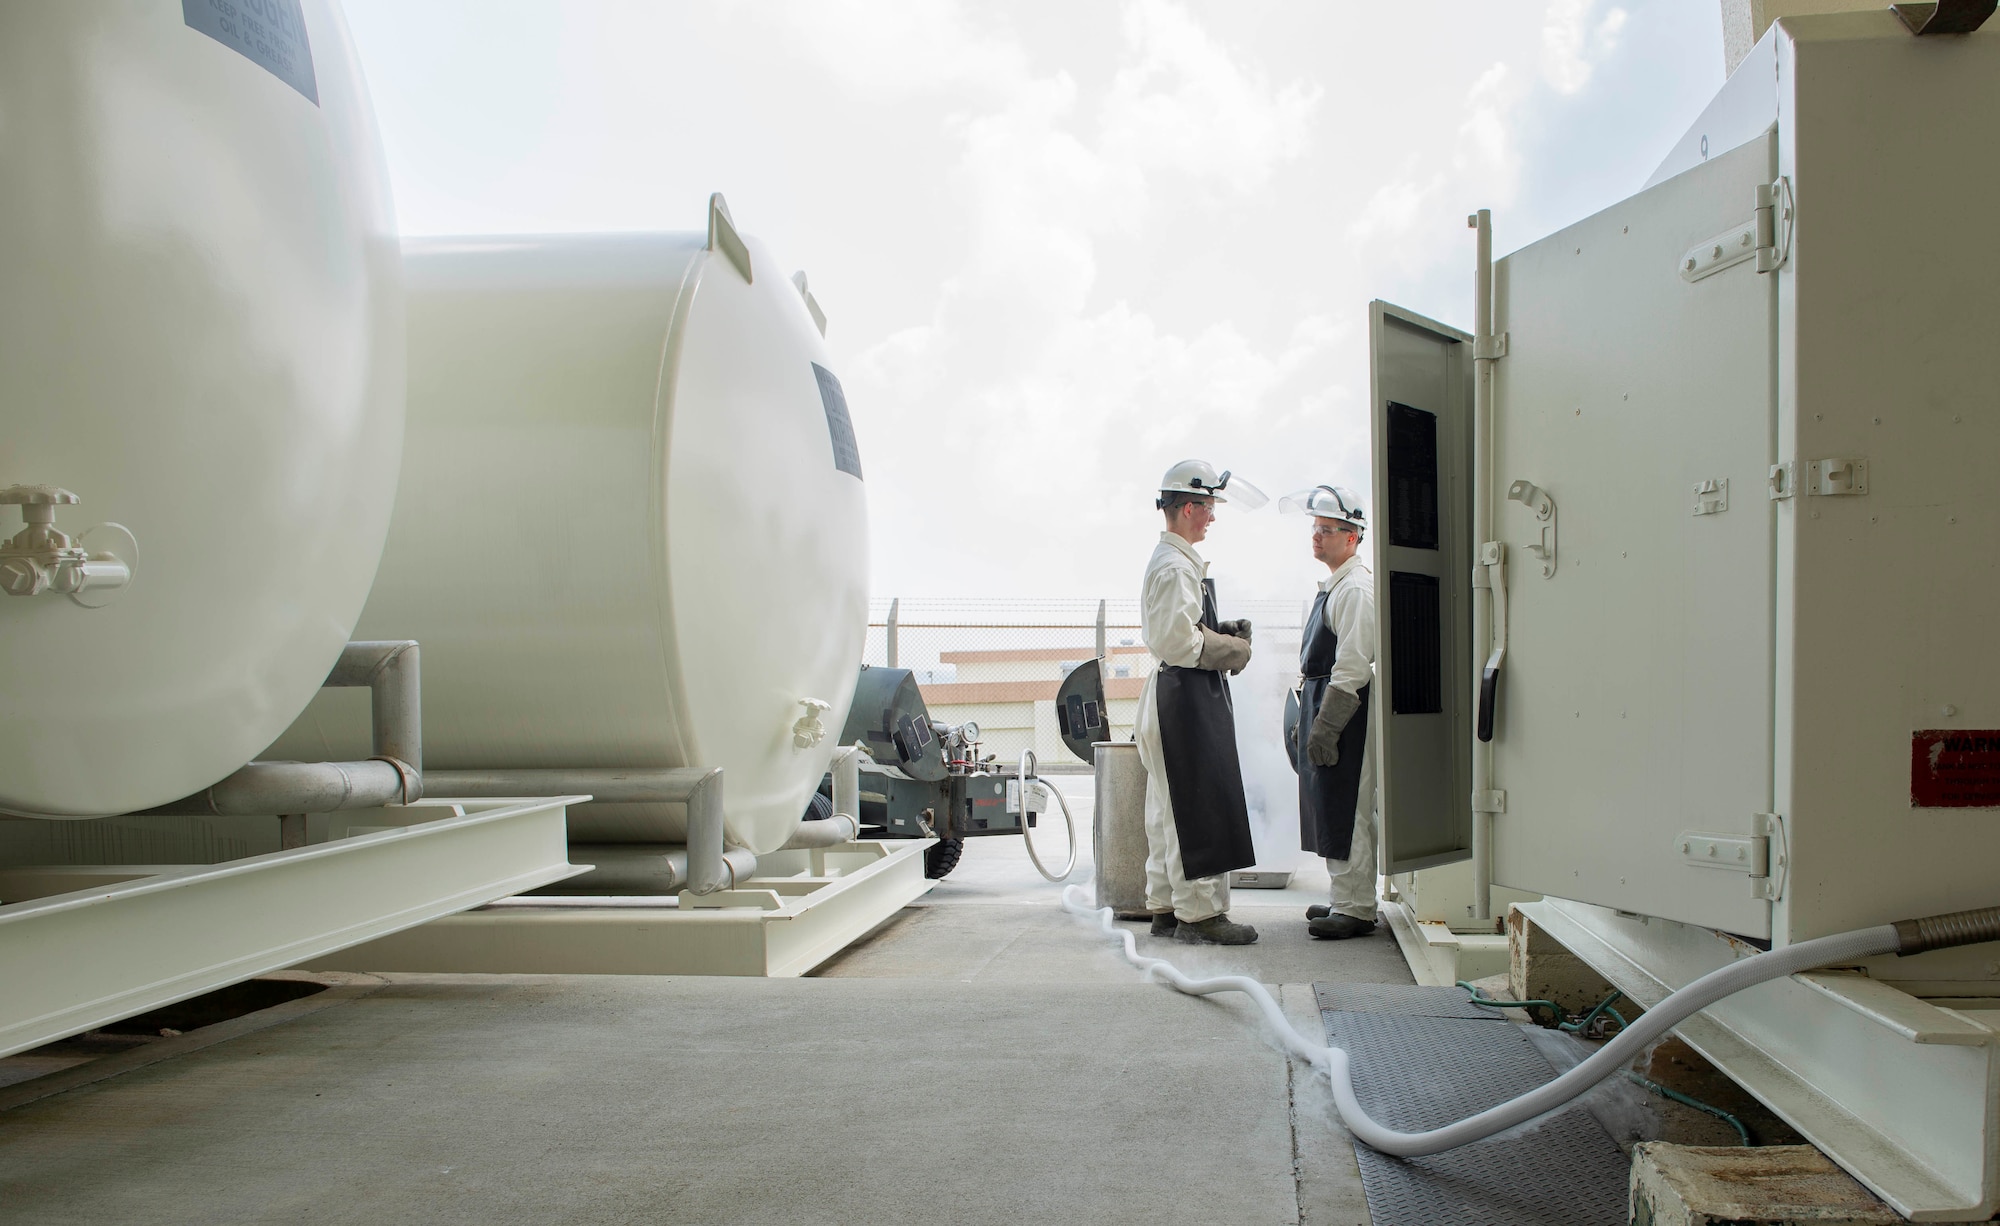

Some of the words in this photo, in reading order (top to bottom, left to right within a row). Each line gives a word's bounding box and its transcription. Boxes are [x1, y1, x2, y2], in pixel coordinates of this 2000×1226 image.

[219, 17, 240, 39] OIL
[244, 31, 253, 48] &
[256, 40, 295, 75] GREASE
[241, 13, 266, 39] FREE
[269, 31, 297, 61] FROM
